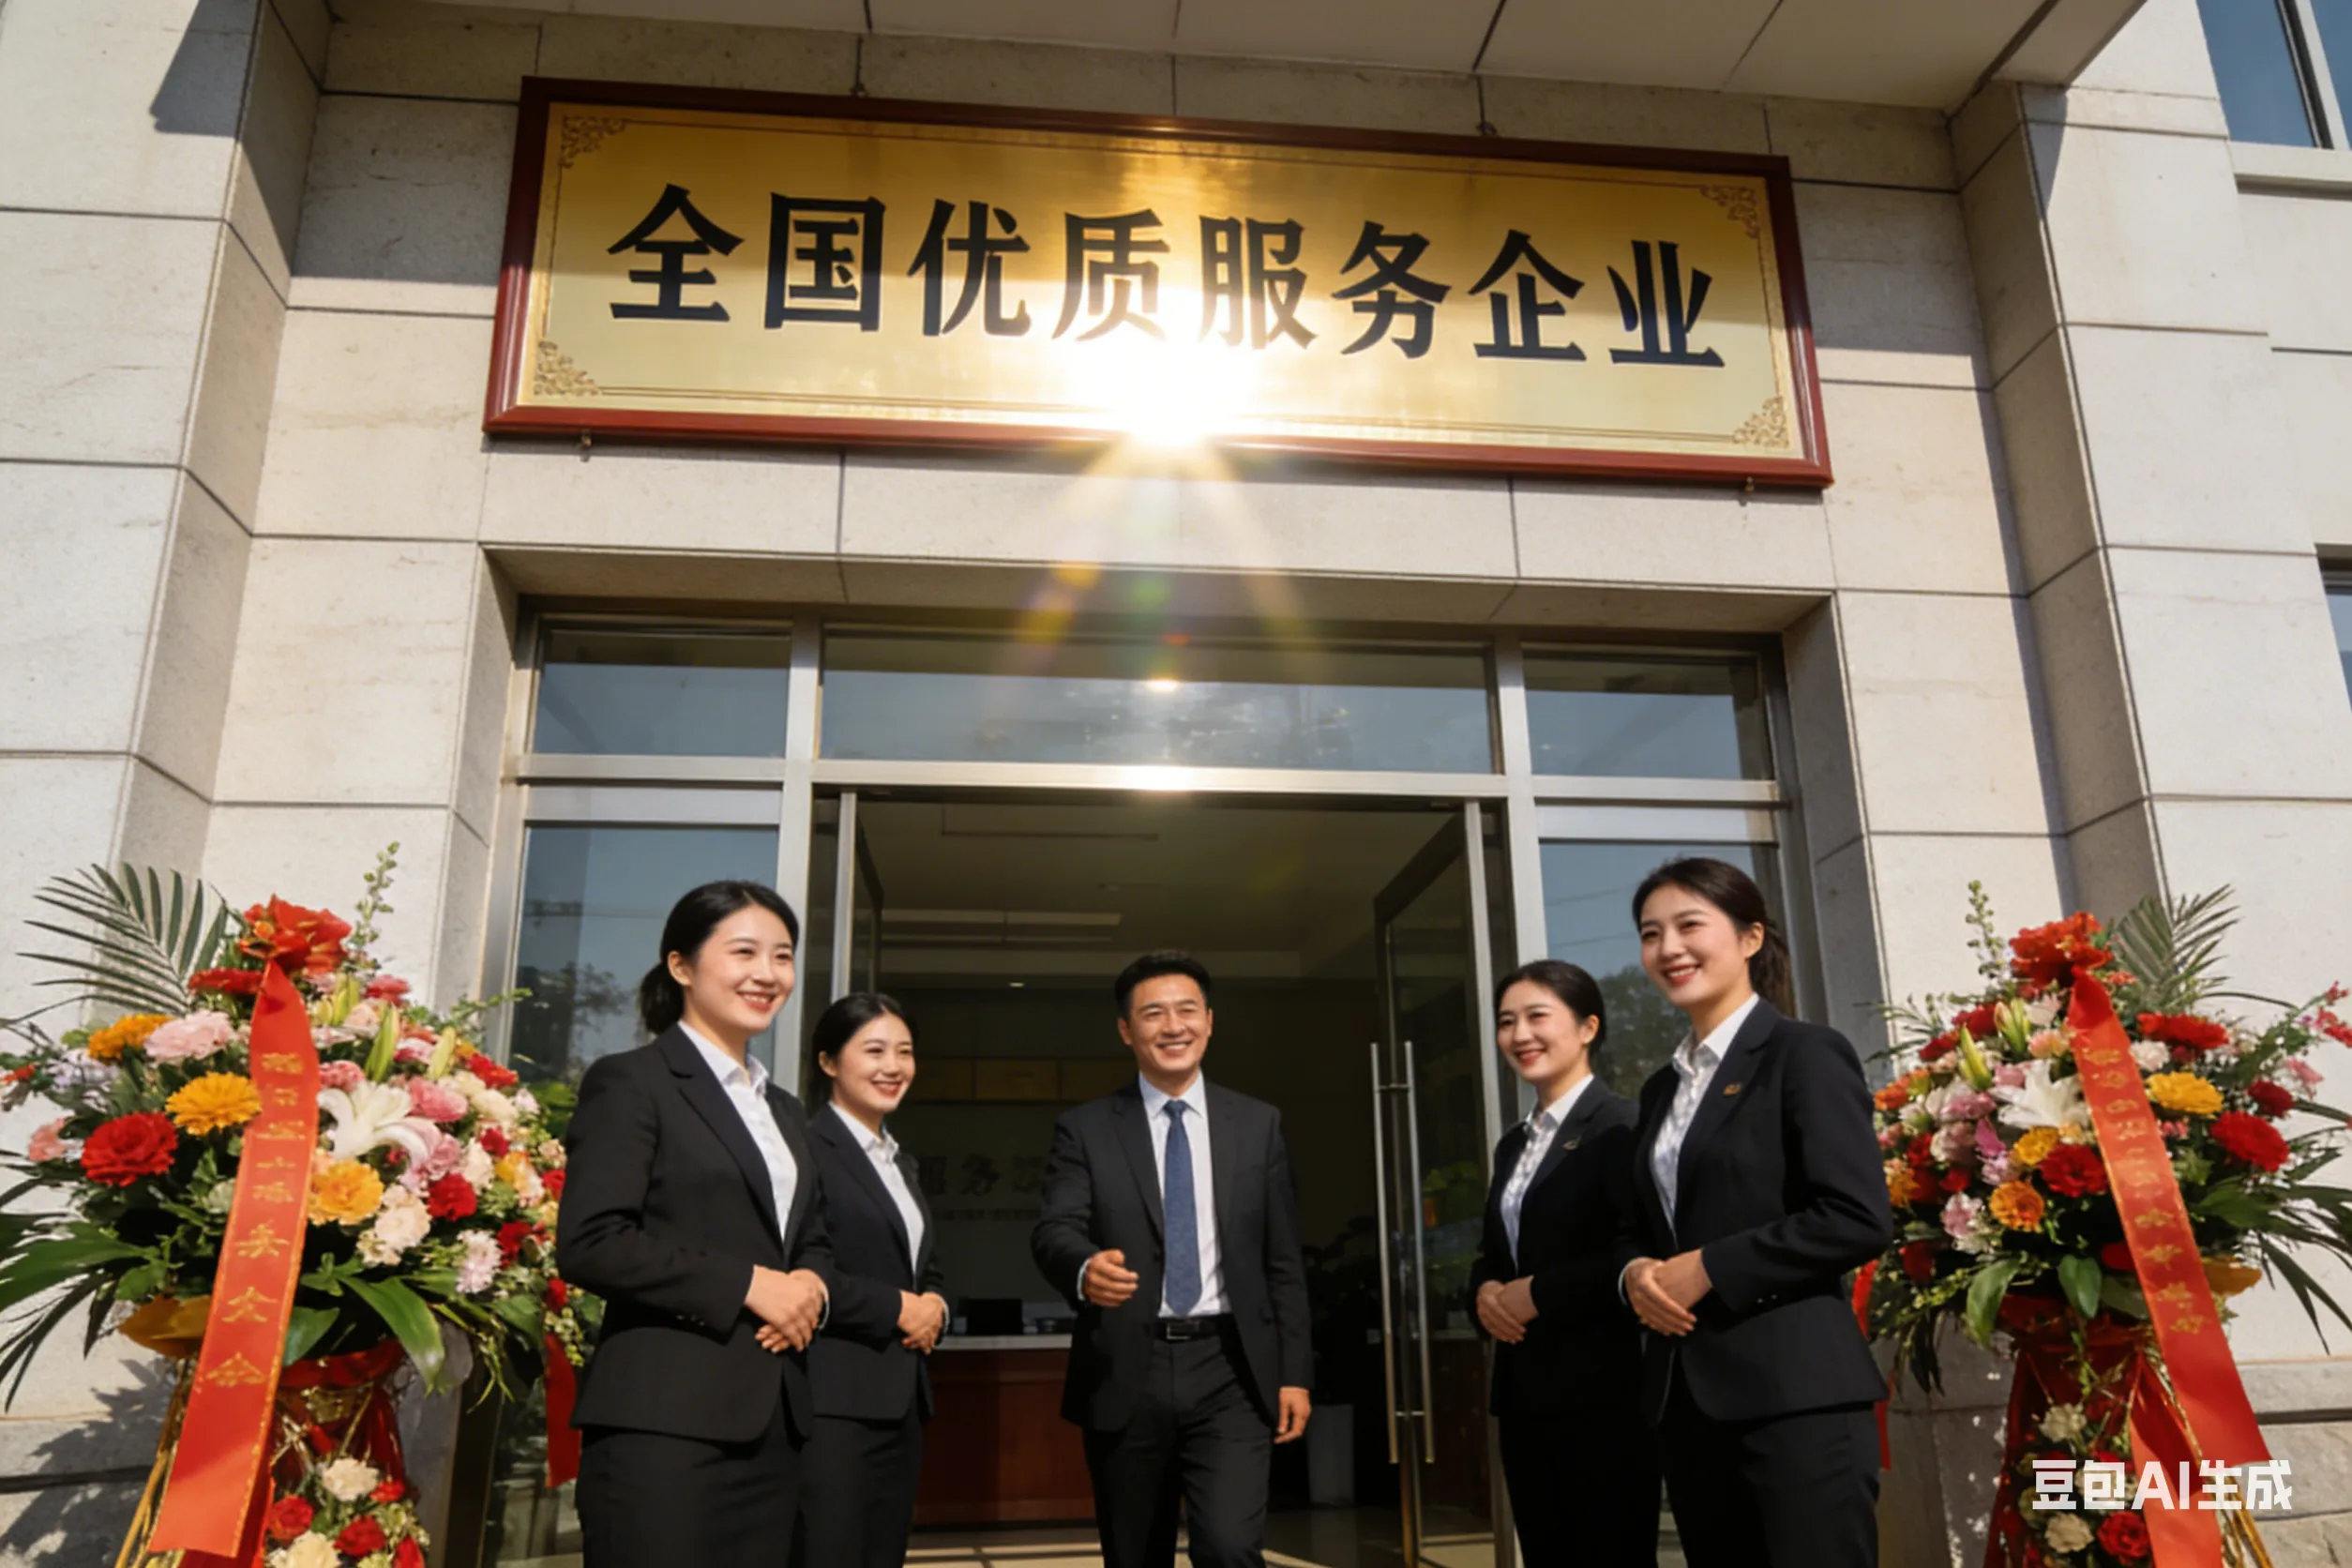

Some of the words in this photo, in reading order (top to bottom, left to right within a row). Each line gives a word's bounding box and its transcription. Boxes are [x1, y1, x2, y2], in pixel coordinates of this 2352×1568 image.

[607, 183, 1725, 369] 全国优质服务企业
